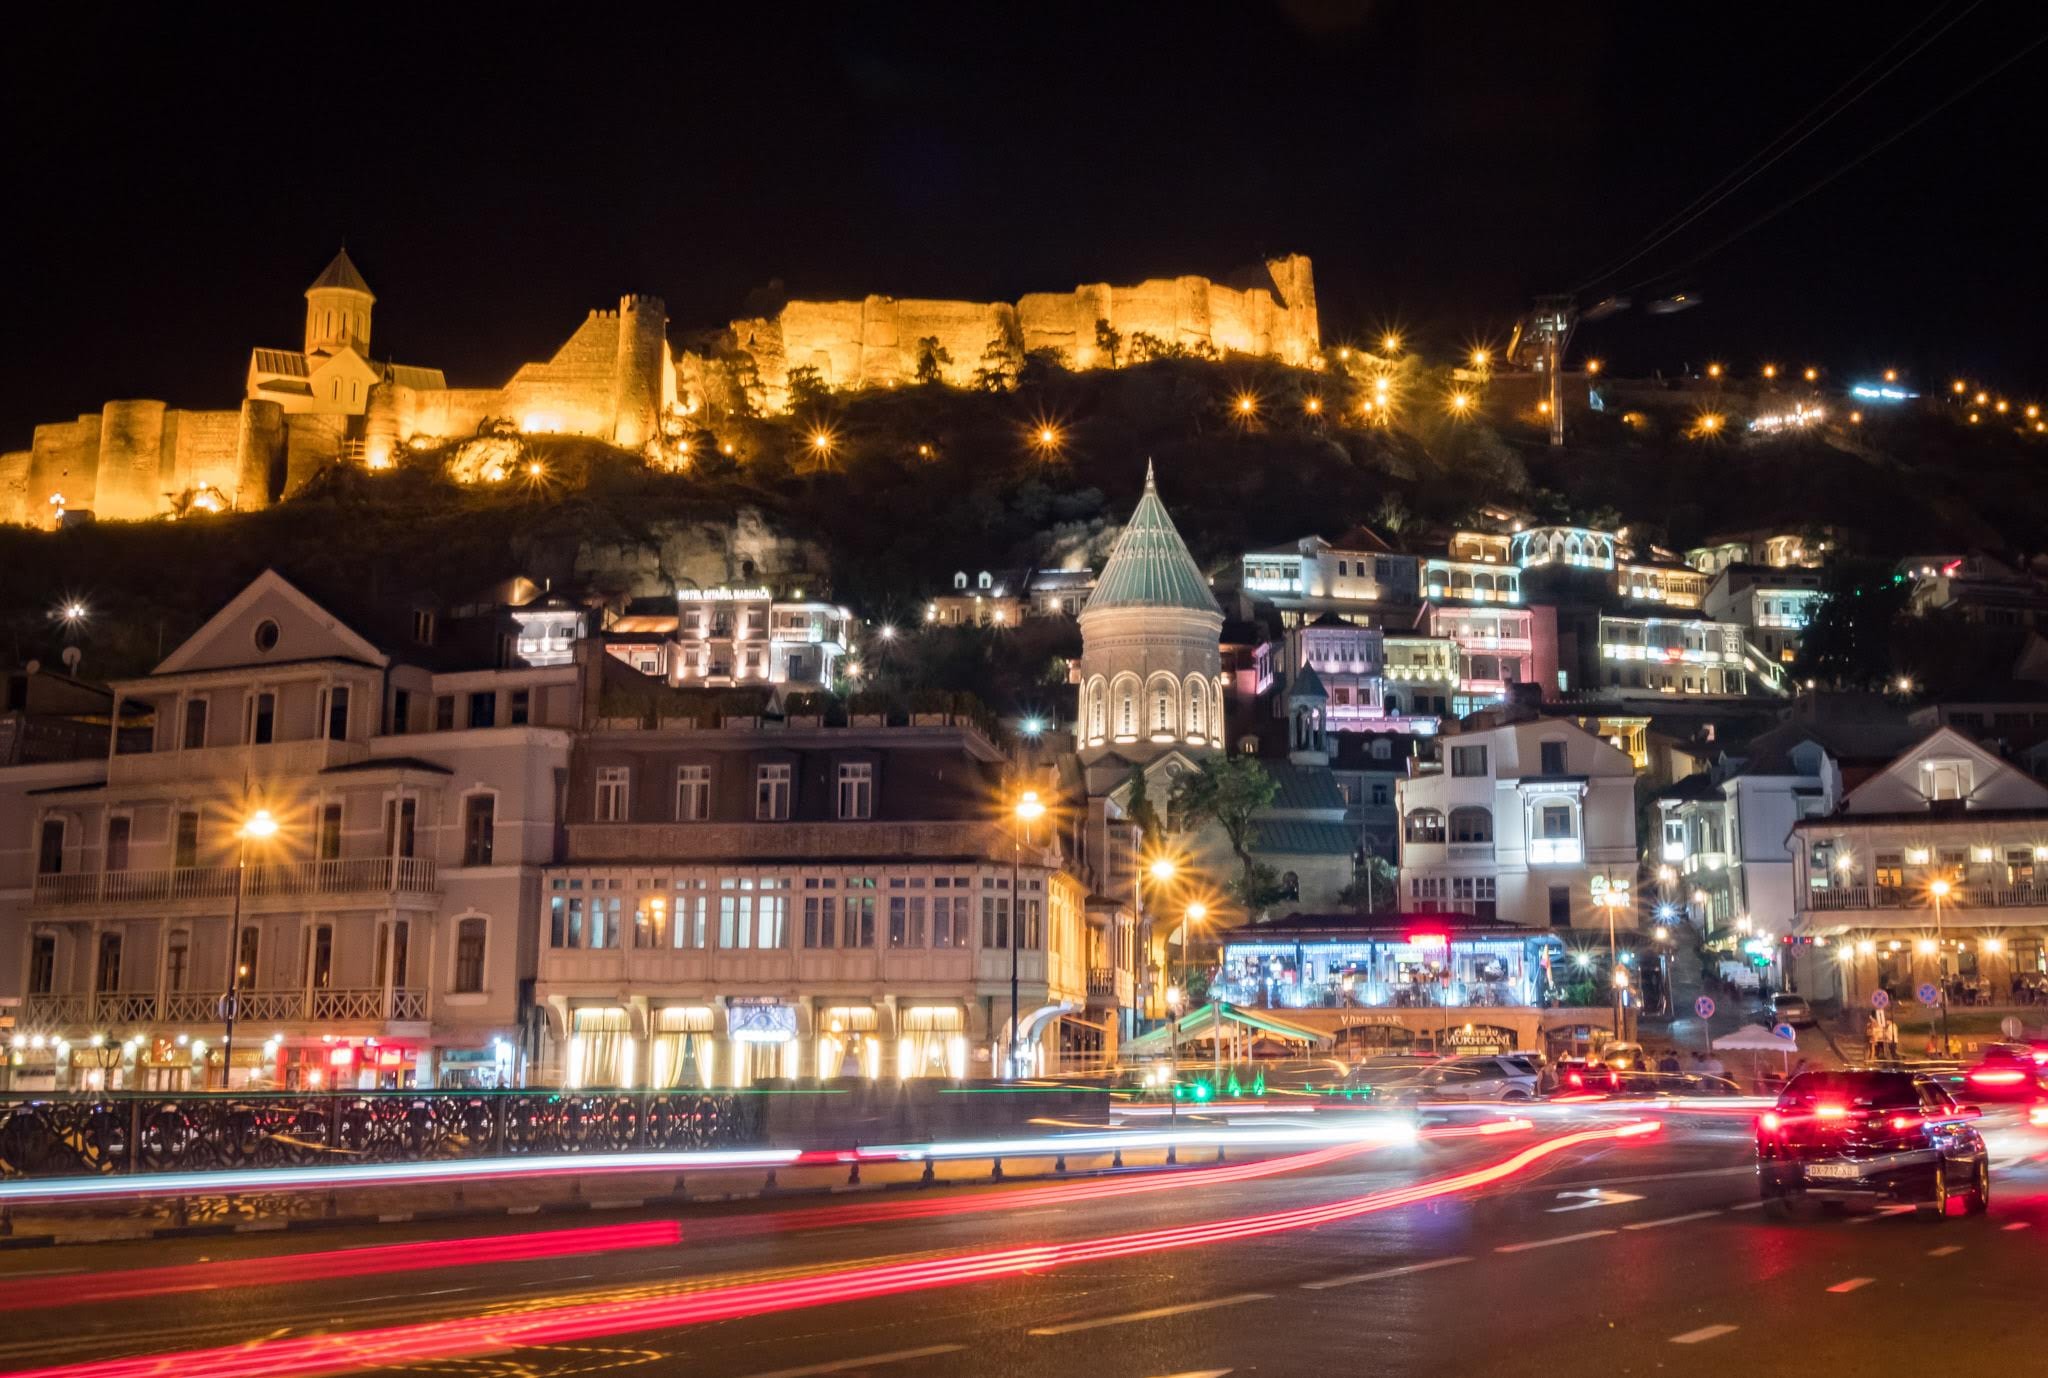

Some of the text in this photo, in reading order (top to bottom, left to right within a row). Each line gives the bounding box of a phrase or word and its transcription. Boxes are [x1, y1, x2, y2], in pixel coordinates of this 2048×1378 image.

[678, 589, 702, 600] HOTEL
[1377, 1015, 1405, 1026] BAR
[1442, 1034, 1511, 1046] MUKHRANI
